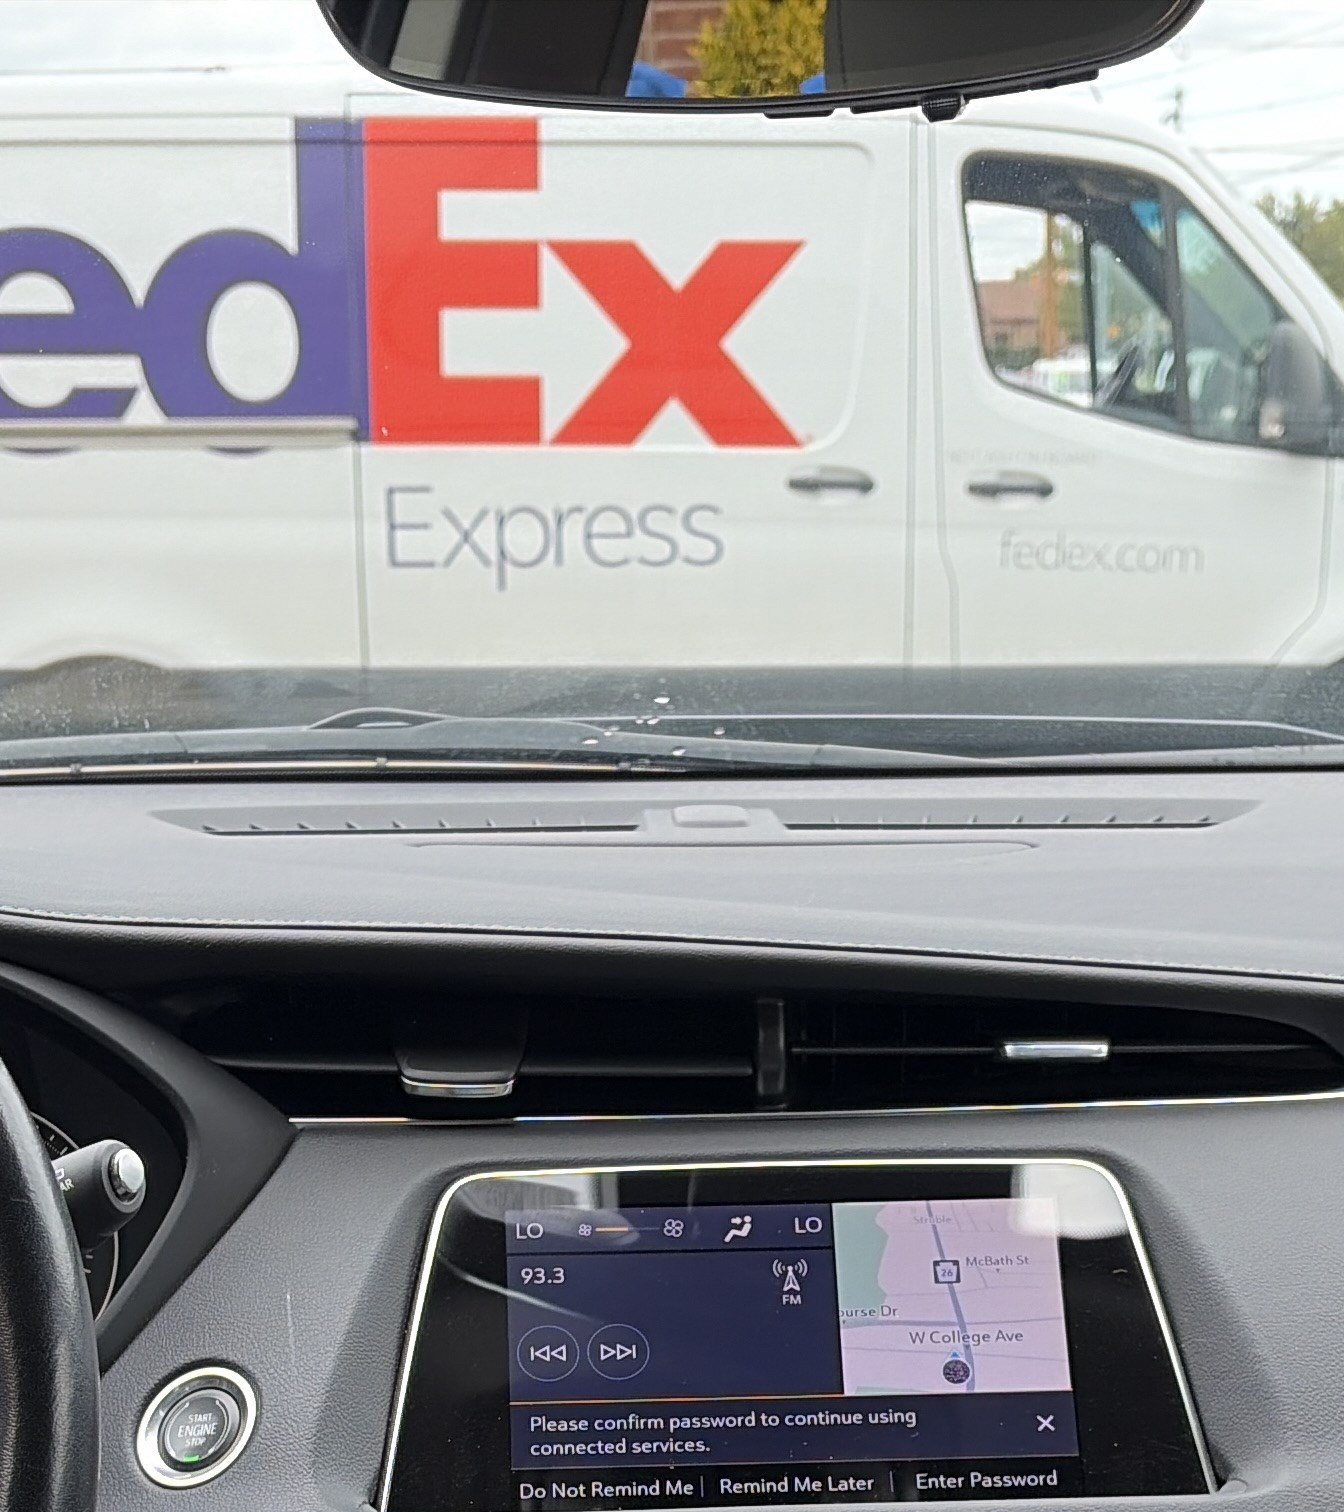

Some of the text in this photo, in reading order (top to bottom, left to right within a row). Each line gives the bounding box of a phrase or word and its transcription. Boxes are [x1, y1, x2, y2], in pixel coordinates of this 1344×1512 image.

[384, 484, 726, 591] Express
[999, 526, 1205, 573] fedex.com
[516, 1222, 543, 1240] LO
[794, 1217, 822, 1234] LO
[965, 1255, 1030, 1267] McBath St
[520, 1267, 565, 1284] 93.3
[941, 1268, 954, 1277] 26
[782, 1294, 801, 1305] FM
[880, 1305, 899, 1317] Dr
[908, 1329, 1024, 1347] W College Ave
[188, 1412, 212, 1423] START
[530, 1409, 917, 1433] Please confirm password to continue using
[177, 1422, 217, 1438] ENGINE
[184, 1438, 207, 1447] STOP
[530, 1437, 711, 1456] connected services.
[719, 1475, 874, 1494] Remind Me Later
[916, 1469, 1058, 1490] Enter Password
[519, 1478, 694, 1499] Do Not Remind Me
